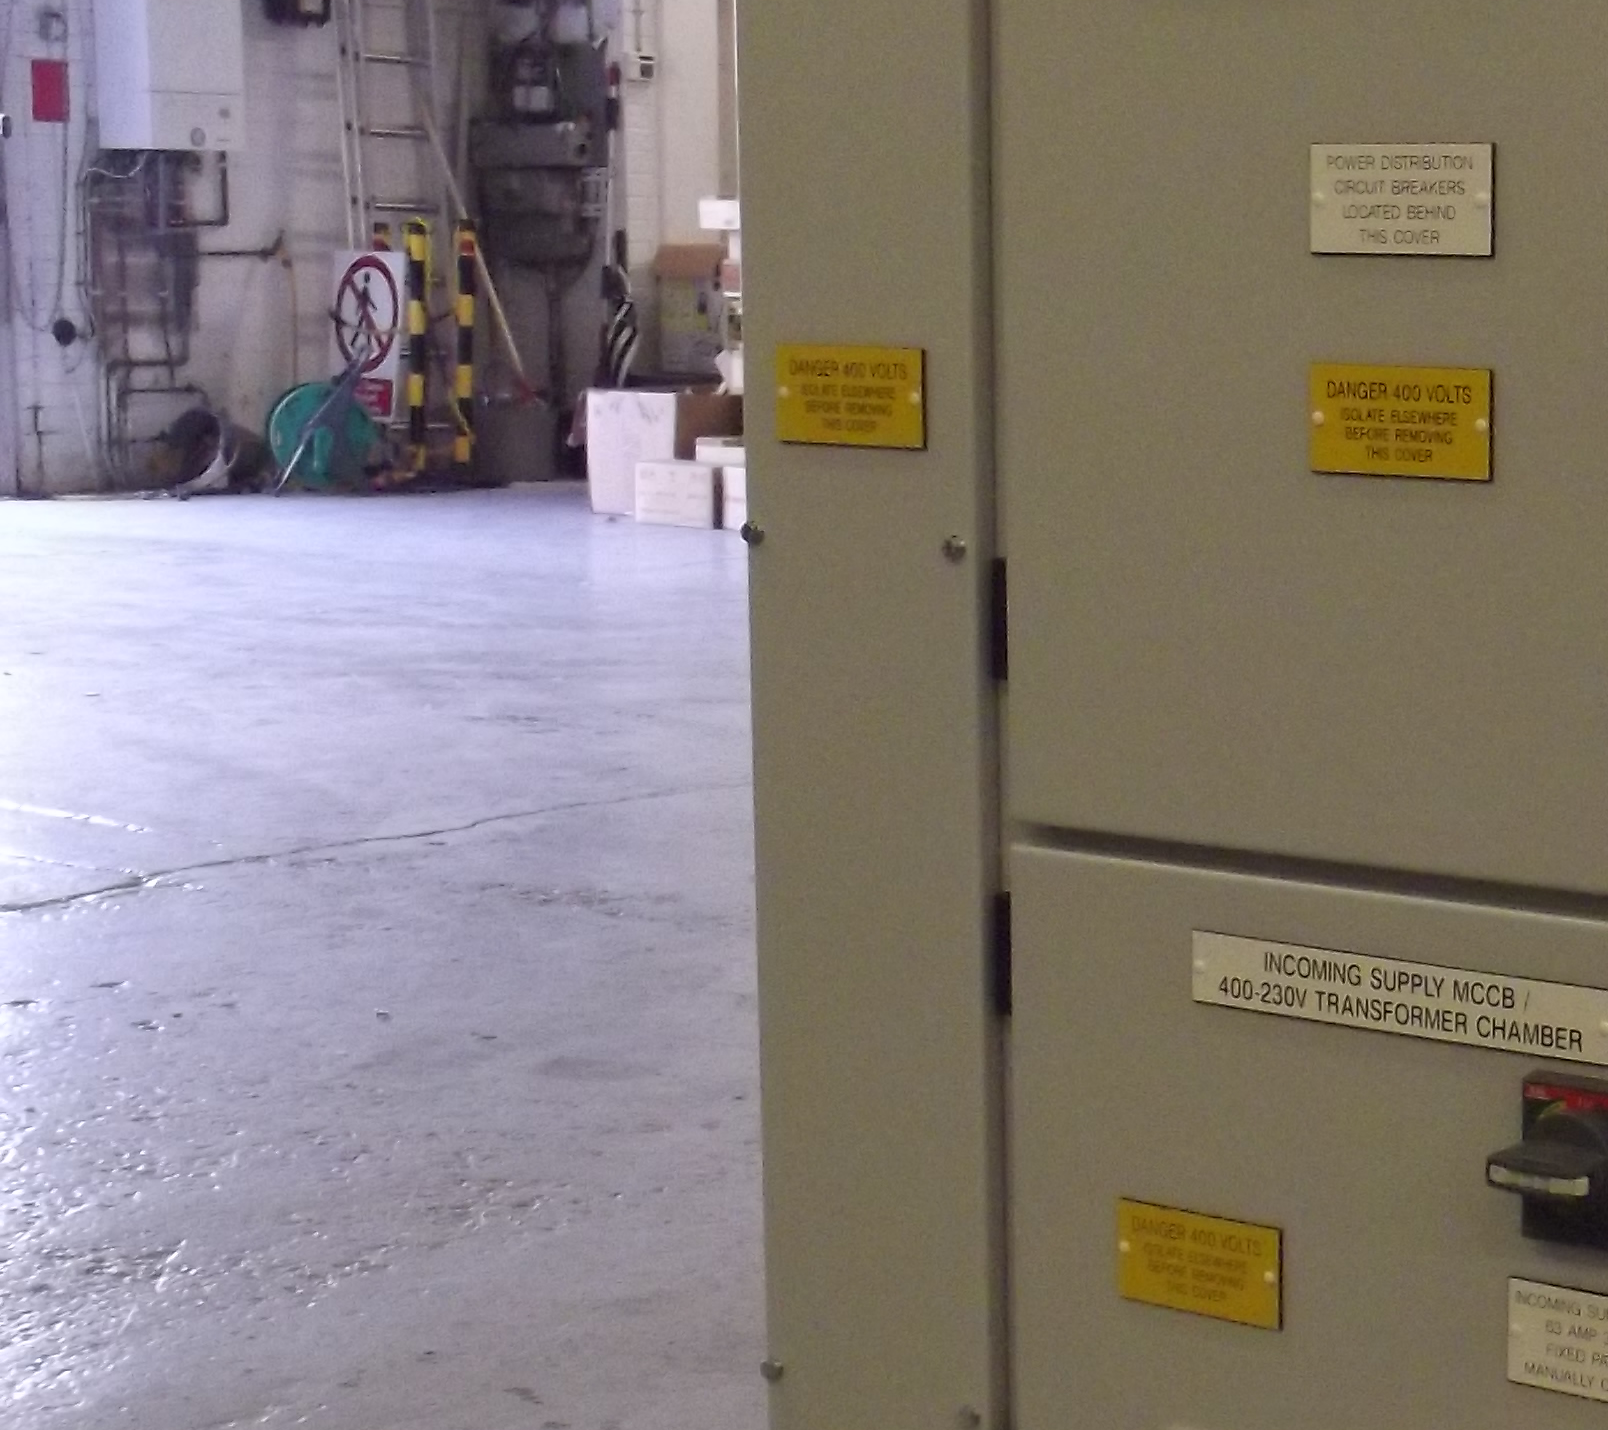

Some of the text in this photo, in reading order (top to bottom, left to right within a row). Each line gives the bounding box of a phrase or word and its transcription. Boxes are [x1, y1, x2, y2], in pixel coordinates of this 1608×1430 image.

[1327, 155, 1473, 170] POWER DISTRIBUTION
[1334, 180, 1466, 195] CIRCUIT BREAKERS
[1343, 205, 1456, 220] LOCATED BEHIND
[1359, 229, 1440, 245] THIS COVER
[1327, 380, 1472, 404] DANGER 400 VOLTS
[1341, 407, 1458, 426] ISOLATE ELSEWHERE
[1345, 426, 1453, 445] BEFORE REMOVING
[1365, 446, 1390, 461] THIS
[1264, 951, 1362, 987] INCOMING
[1370, 968, 1445, 999] SUPPLY
[1452, 979, 1516, 1010] MCCB
[1219, 975, 1584, 1054] 400-230V TRANSFORMER CHAMBER
[1221, 1234, 1262, 1258] VOLTS
[1514, 1290, 1581, 1317] INCOMING
[1567, 1324, 1598, 1342] AMP
[1546, 1343, 1585, 1363] FIXED
[1524, 1362, 1594, 1388] MANUALLY
